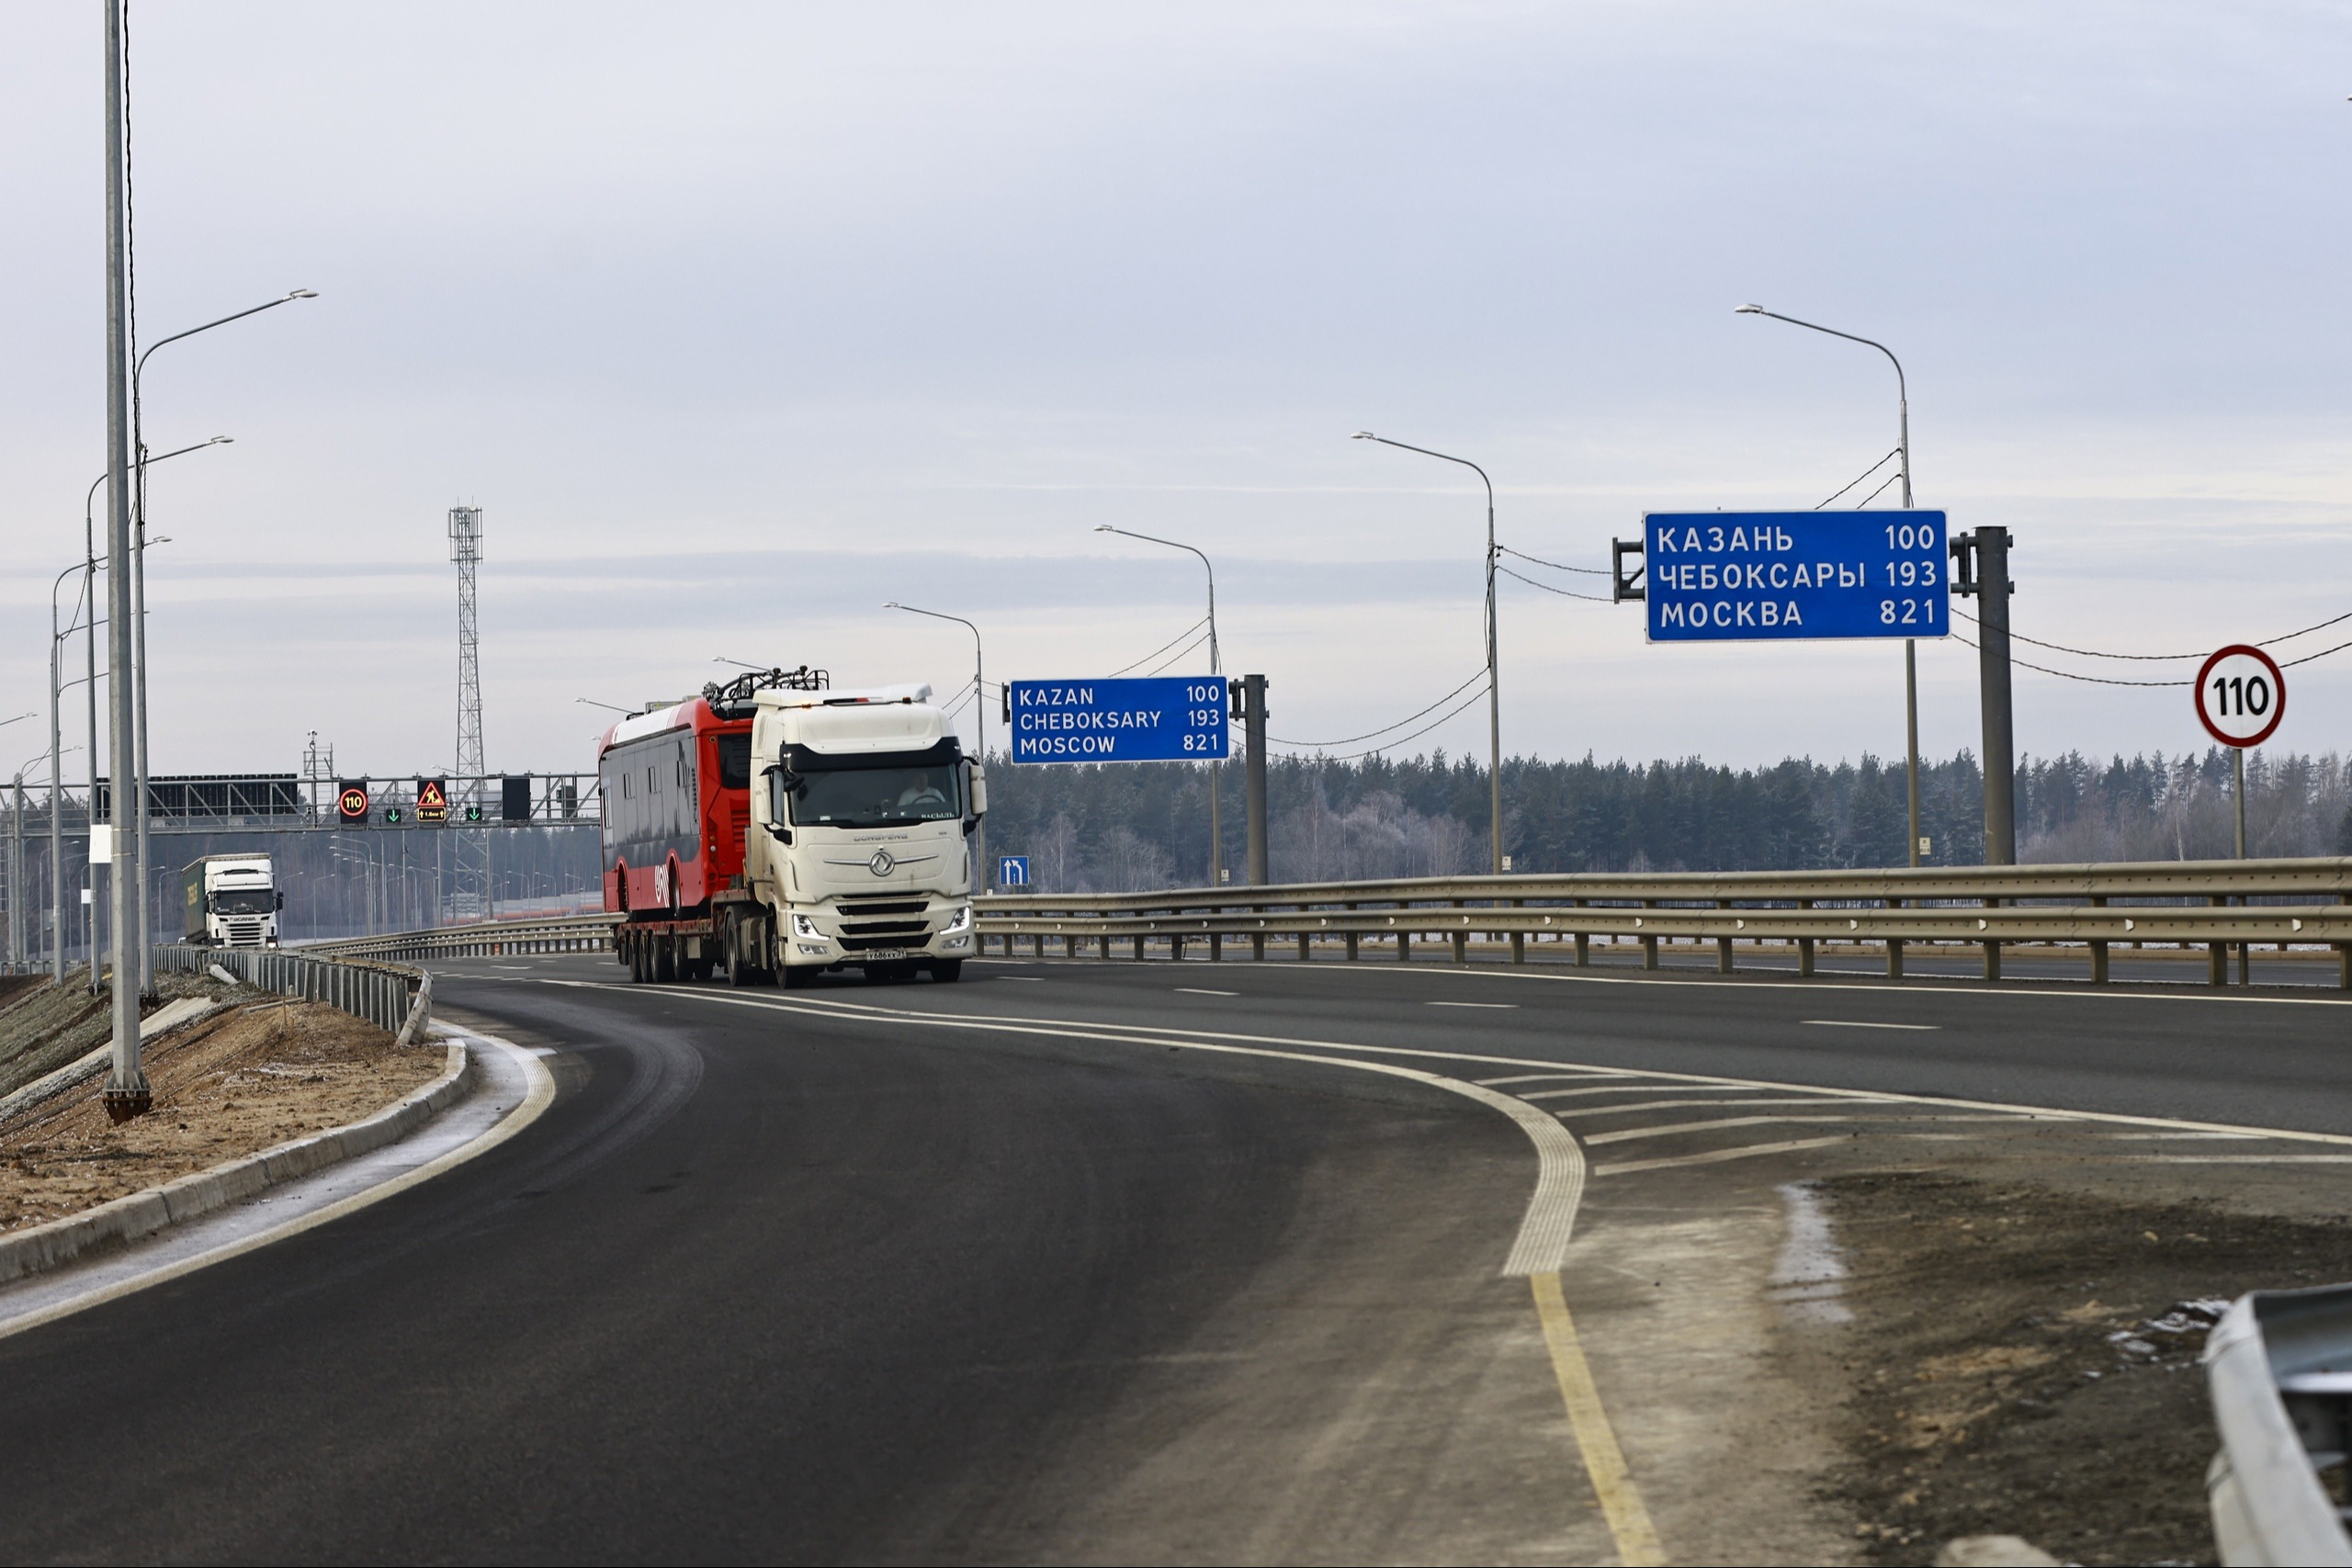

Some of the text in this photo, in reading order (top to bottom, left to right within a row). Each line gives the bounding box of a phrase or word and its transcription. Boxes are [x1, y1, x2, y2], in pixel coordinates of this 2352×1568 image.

[1658, 525, 1935, 553] КАЗАНЬ 100
[1659, 560, 1937, 590] ЧЕБОКСАРЫ 193
[1661, 598, 1933, 627] МОСКВА 821
[1020, 685, 1219, 706] KAZAN 100
[2212, 675, 2269, 716] 110
[1020, 708, 1219, 730] CHEBOKSARY 193
[1021, 733, 1217, 755] MOSCOW 821
[345, 795, 363, 808] 110
[853, 832, 908, 842] DONGFENG
